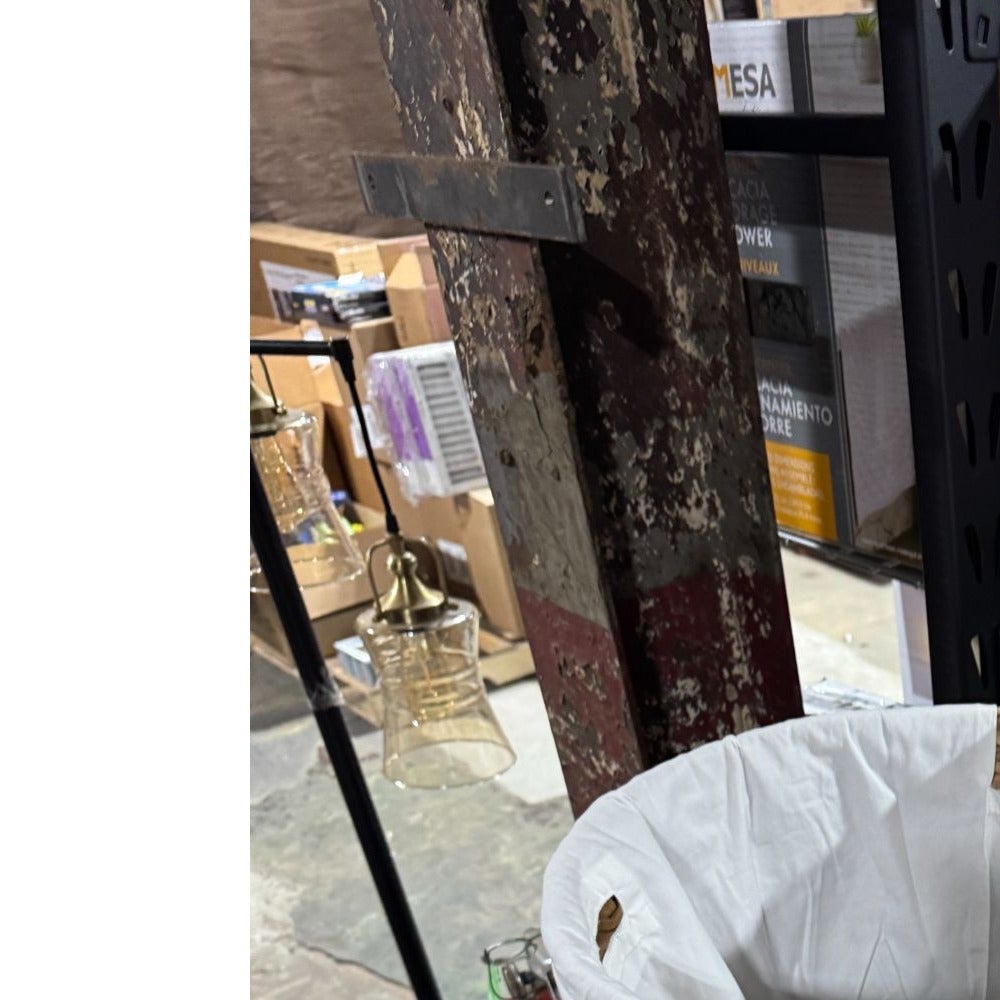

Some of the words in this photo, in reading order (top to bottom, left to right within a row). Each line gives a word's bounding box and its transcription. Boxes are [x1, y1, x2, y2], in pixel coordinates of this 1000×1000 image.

[712, 63, 776, 98] MESA
[728, 177, 770, 201] CACIA
[735, 224, 773, 248] OWER
[760, 376, 793, 398] ACIA
[760, 395, 833, 426] NAMIENTO
[762, 414, 793, 438] ORRE
